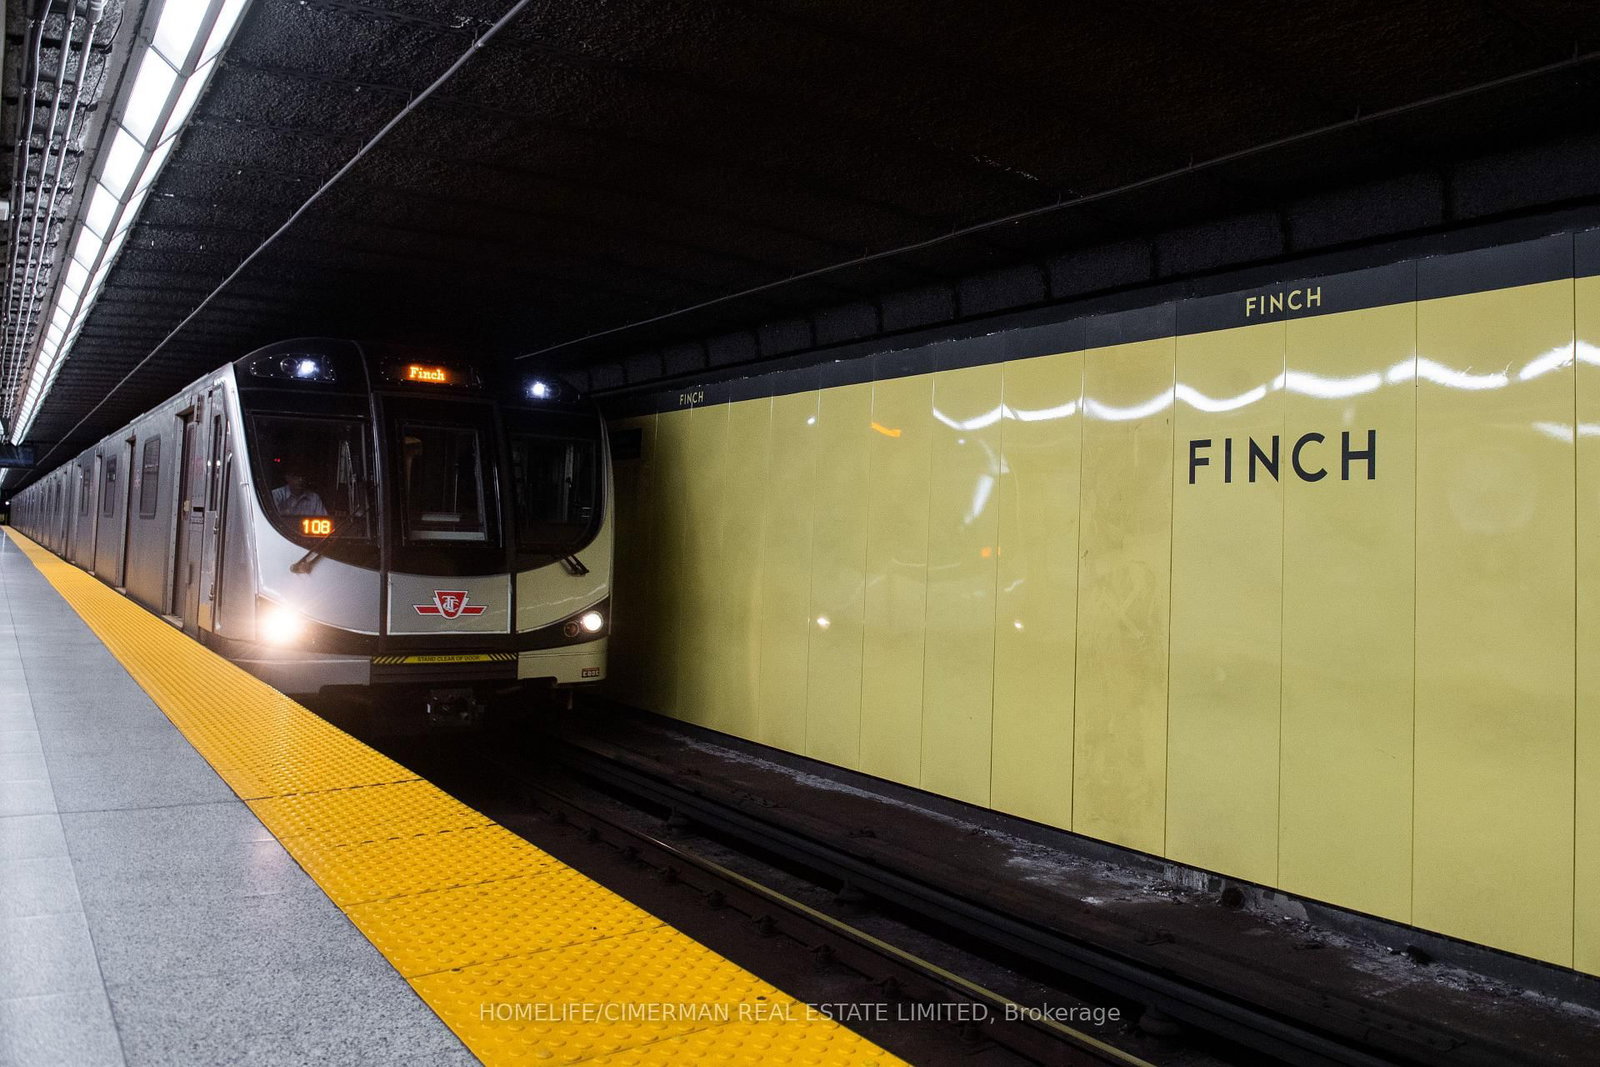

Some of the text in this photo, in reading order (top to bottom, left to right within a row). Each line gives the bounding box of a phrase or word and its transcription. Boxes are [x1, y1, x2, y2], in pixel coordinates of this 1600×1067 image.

[1246, 286, 1321, 317] FINCH
[409, 366, 445, 381] Finch
[679, 391, 704, 405] FINCH
[1189, 429, 1376, 485] FINCH
[302, 519, 331, 534] 108
